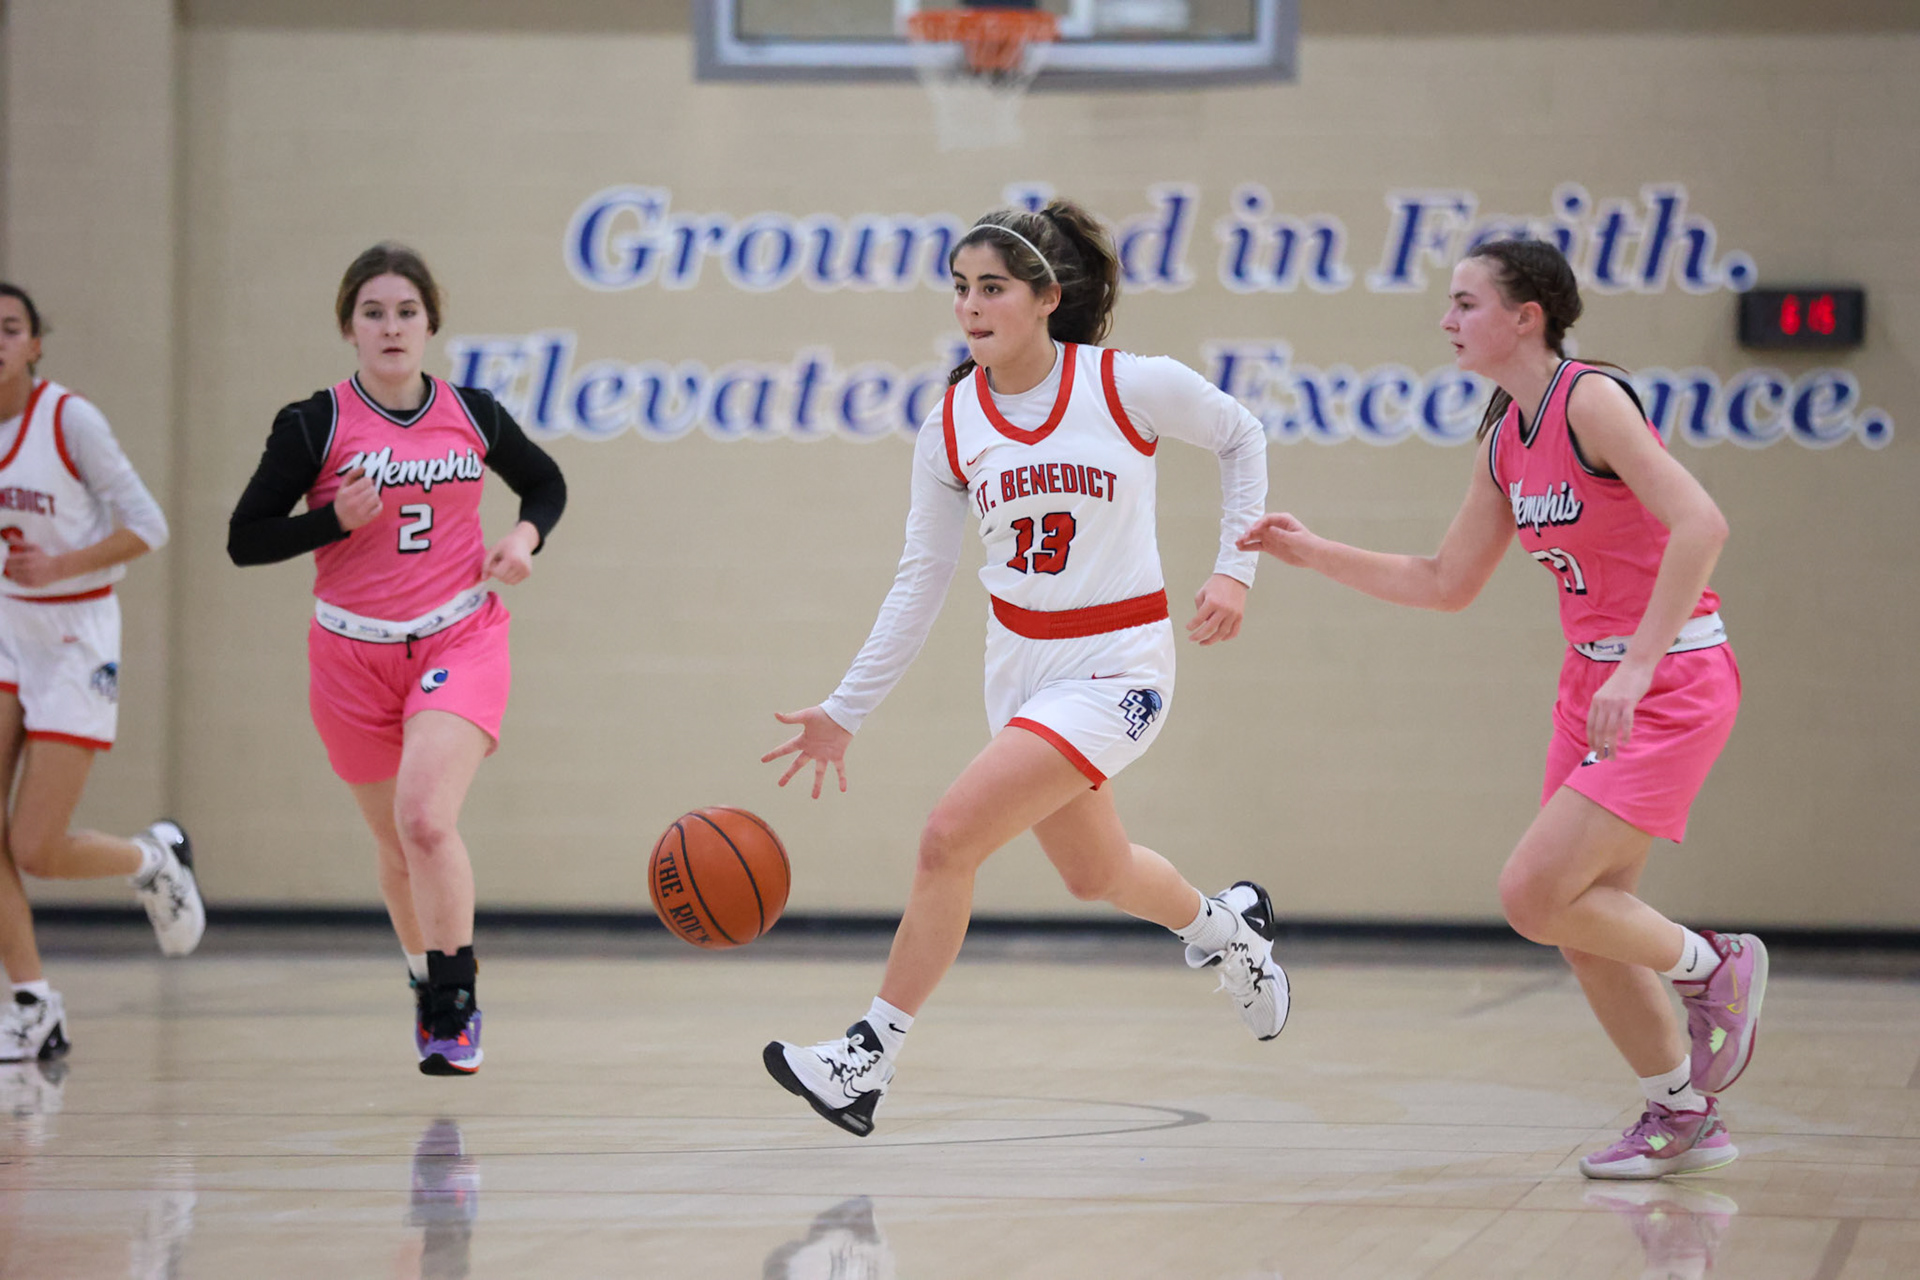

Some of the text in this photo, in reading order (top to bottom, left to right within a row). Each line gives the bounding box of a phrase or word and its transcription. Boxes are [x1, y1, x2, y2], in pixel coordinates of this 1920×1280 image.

[568, 185, 1200, 291] Ground
[1217, 185, 1351, 291] in
[1204, 340, 1893, 447] Excence.
[336, 446, 484, 497] Memphis
[1000, 462, 1117, 502] BENEDICT
[397, 503, 433, 553] 2
[1508, 478, 1585, 538] Memphis
[1006, 511, 1077, 576] 13
[660, 852, 713, 944] THE ROCK
